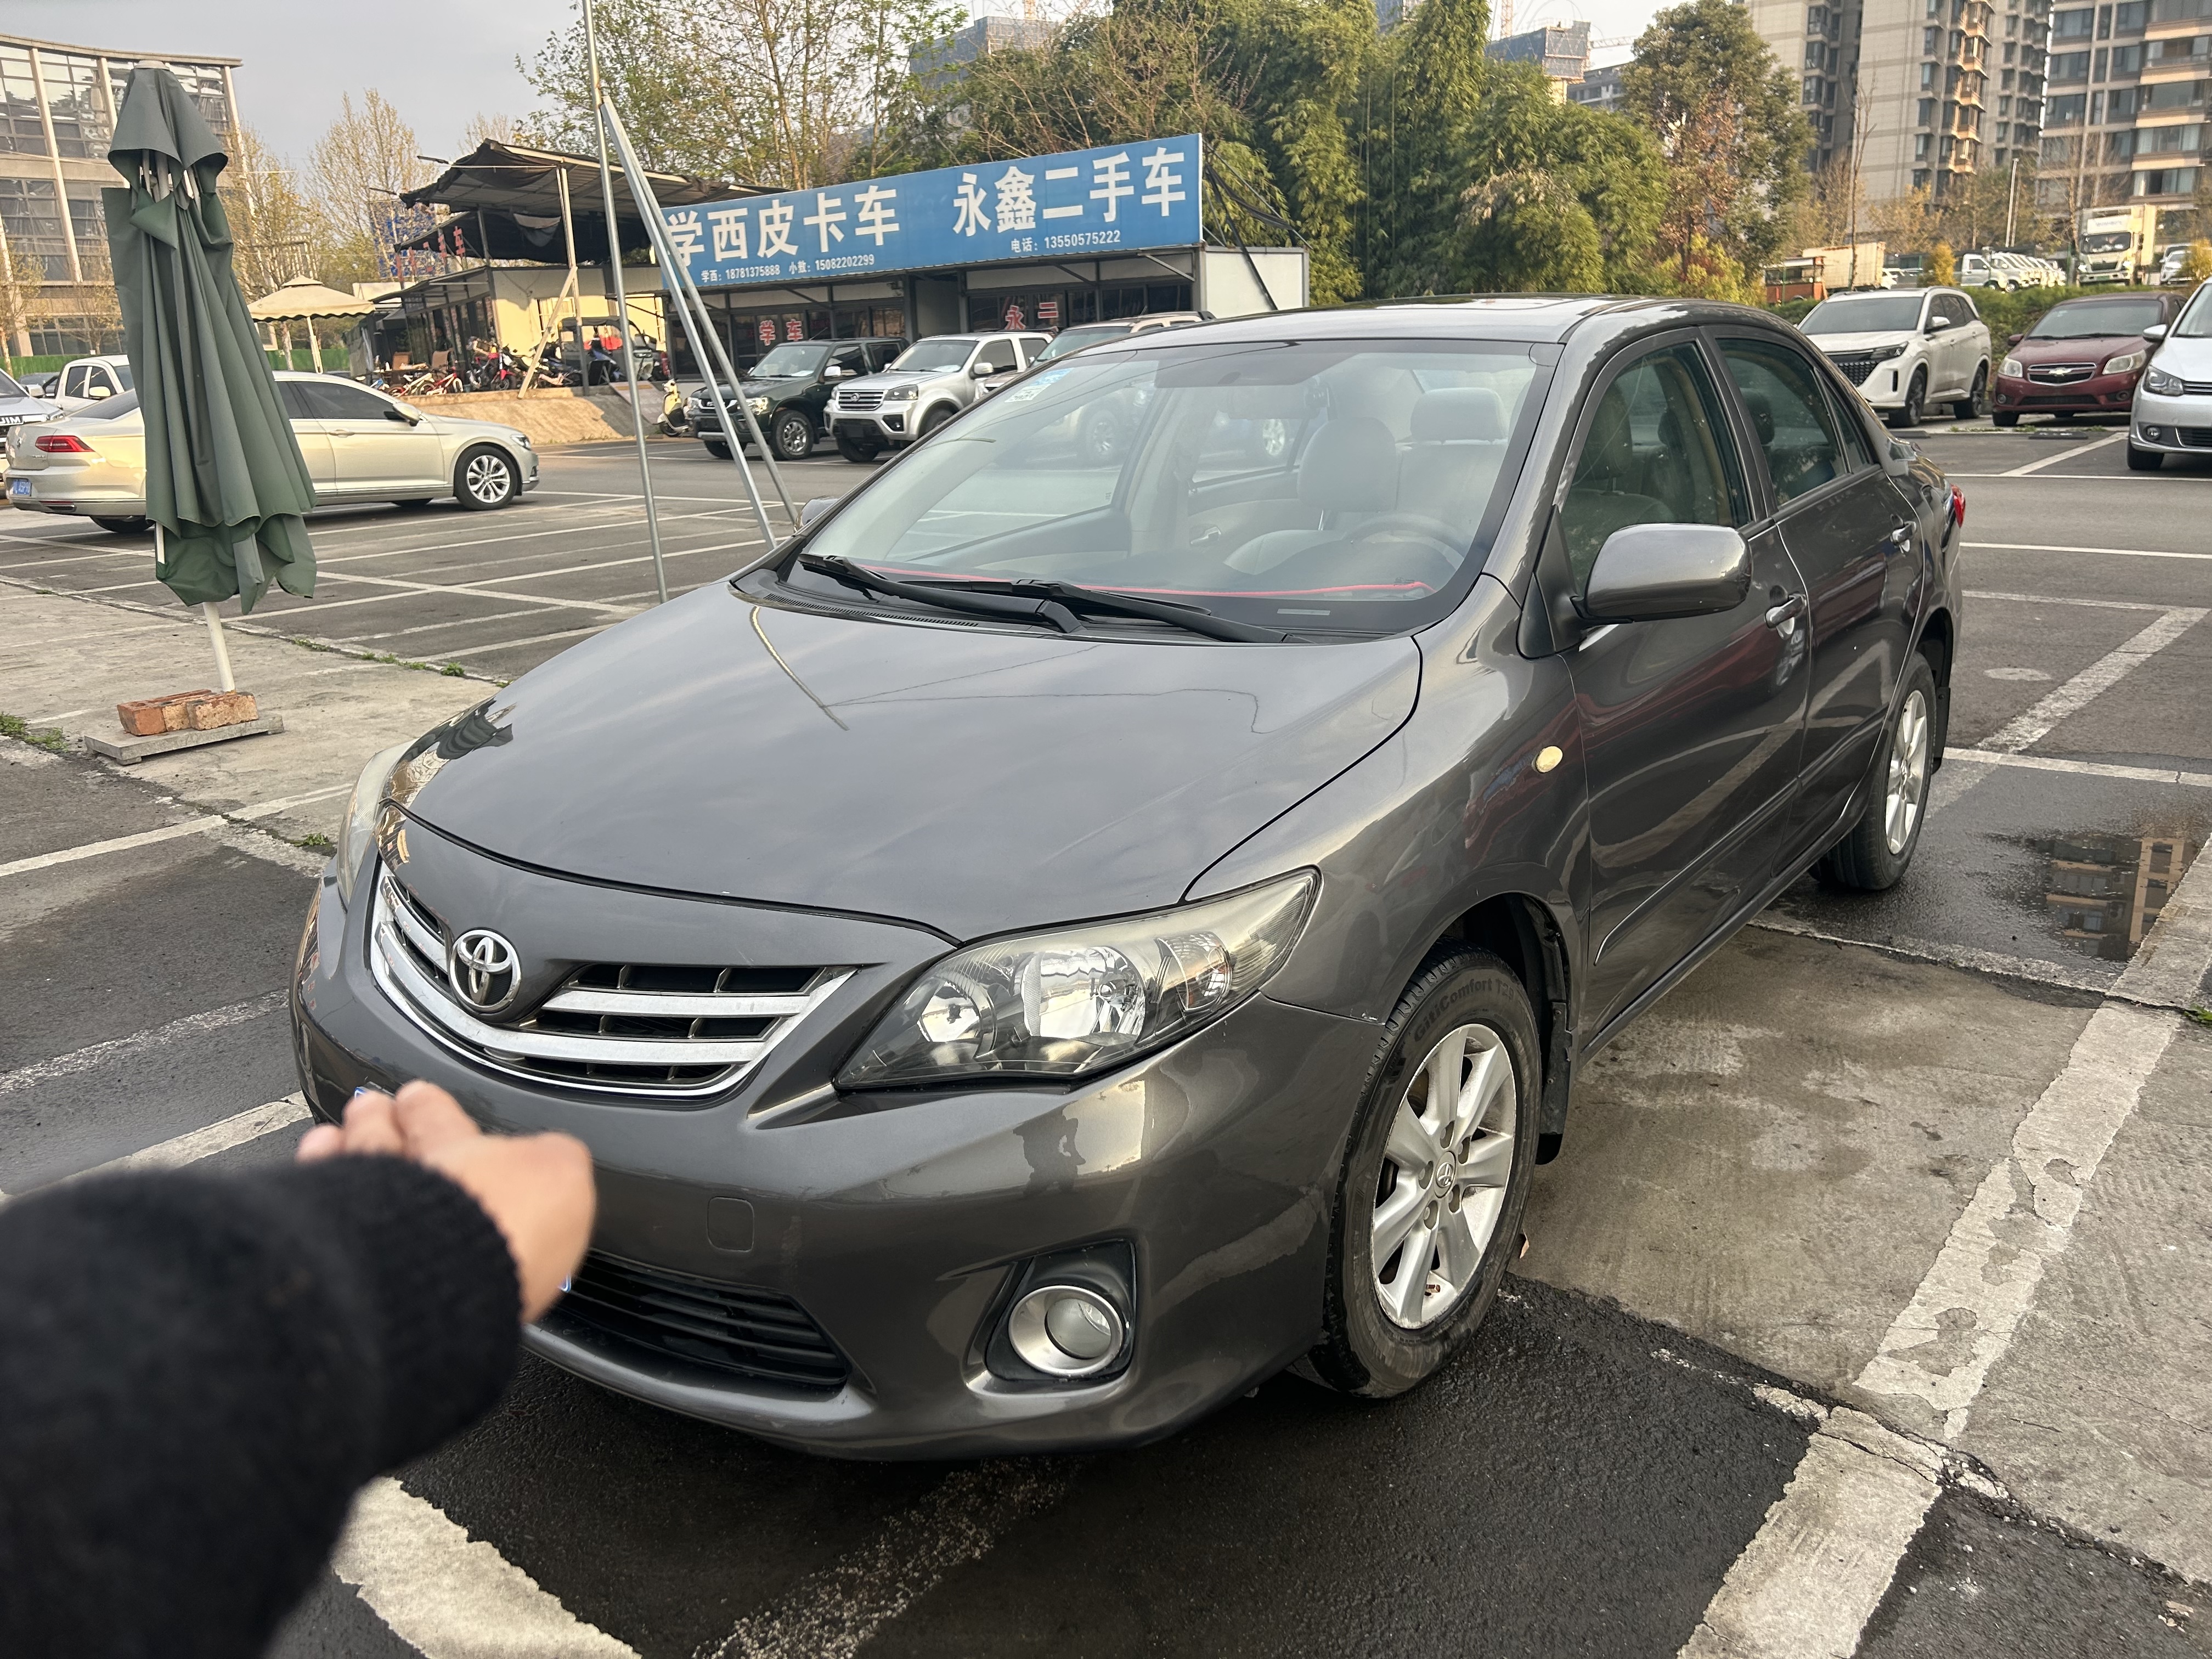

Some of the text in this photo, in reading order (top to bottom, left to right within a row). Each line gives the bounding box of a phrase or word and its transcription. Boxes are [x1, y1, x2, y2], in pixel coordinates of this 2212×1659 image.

[952, 146, 1186, 236] 永鑫二手车
[668, 185, 900, 267] 学西皮卡车
[1044, 229, 1121, 249] 13550575222
[814, 253, 875, 270] 15082202299
